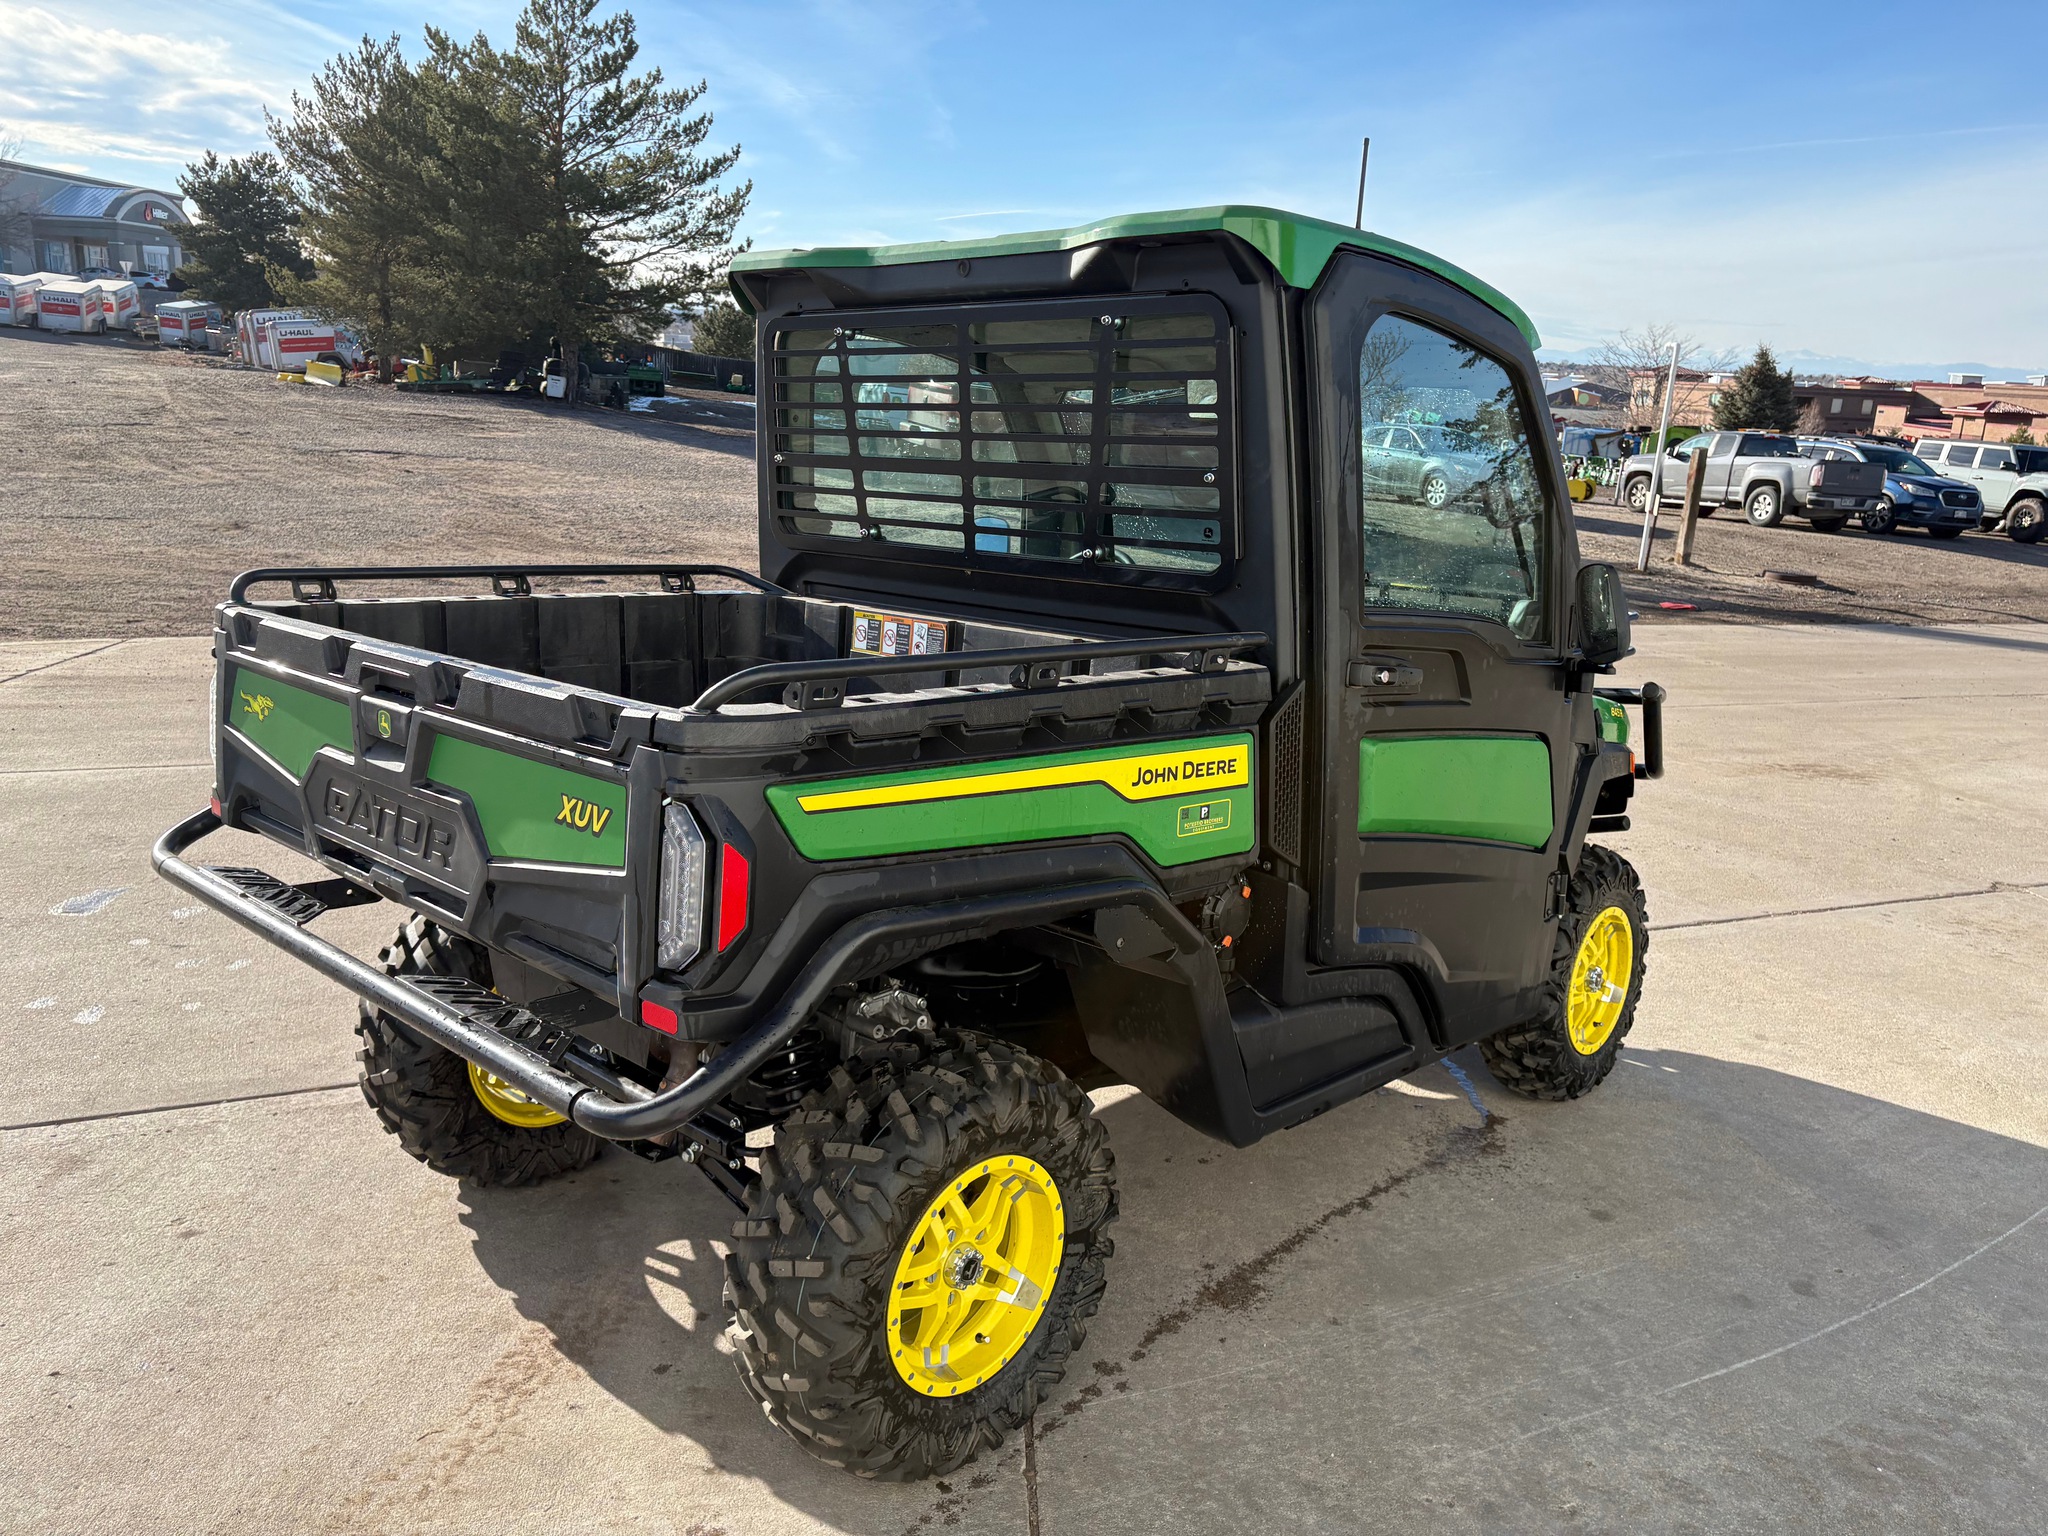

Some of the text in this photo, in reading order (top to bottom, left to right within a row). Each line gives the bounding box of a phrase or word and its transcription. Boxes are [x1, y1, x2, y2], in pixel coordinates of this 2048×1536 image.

[43, 295, 78, 304] U-HAUL
[159, 310, 181, 318] U-HAUL
[279, 329, 315, 337] U-HAUL
[1131, 758, 1237, 787] JOHN DEERE
[323, 776, 456, 871] GATOR
[555, 793, 613, 838] XUV
